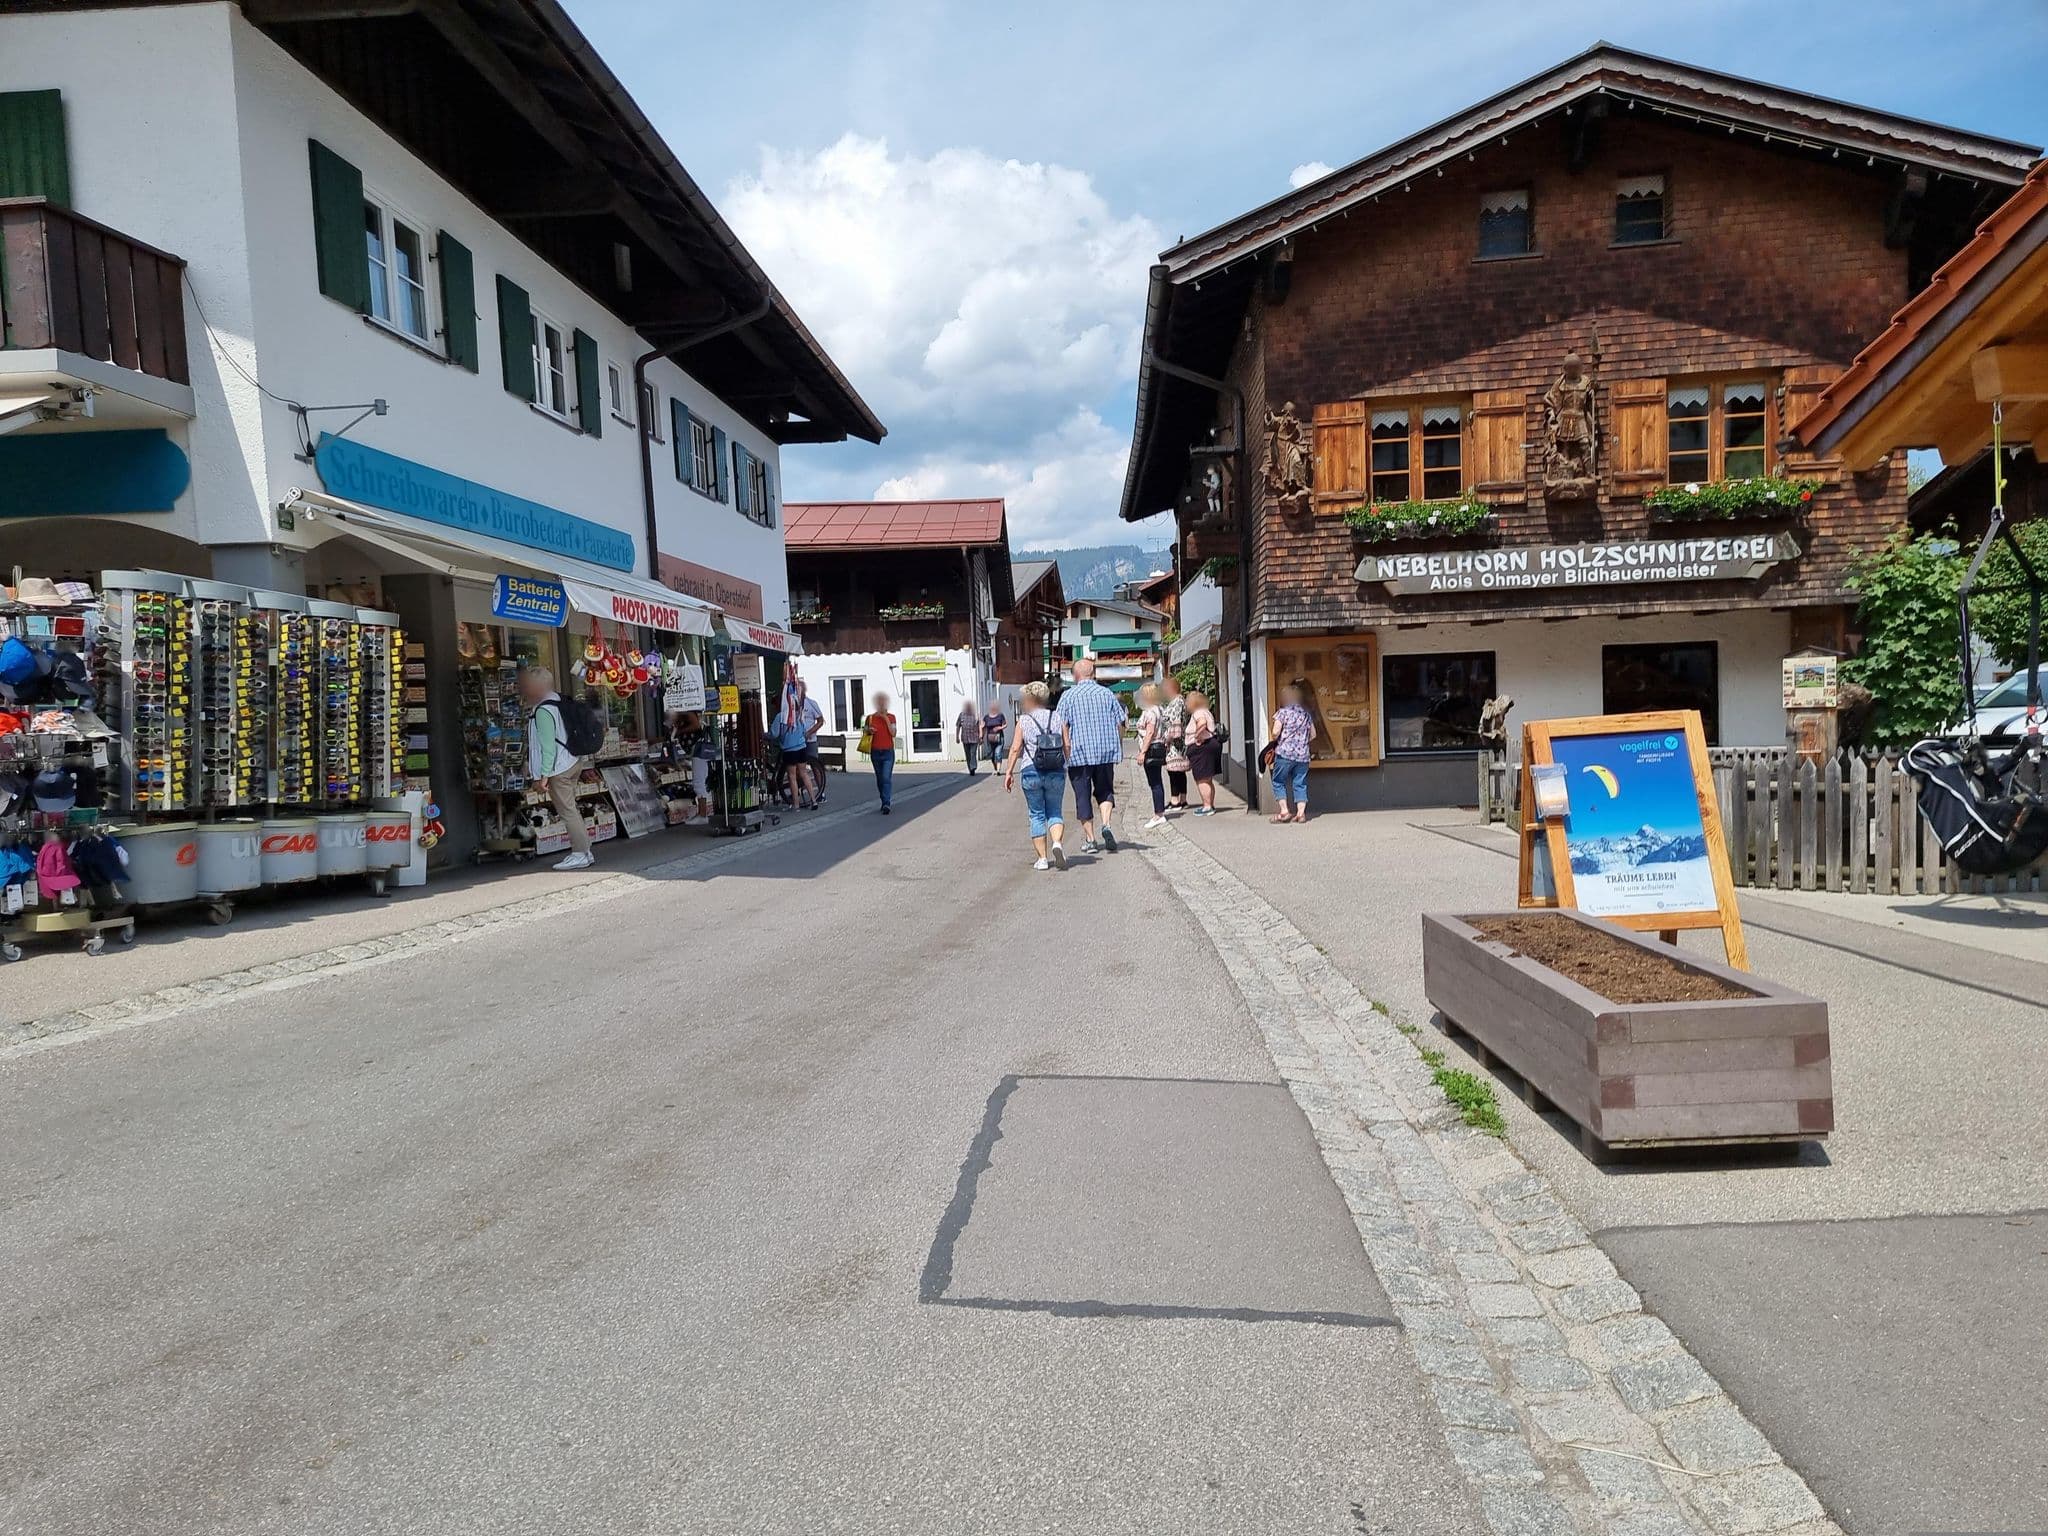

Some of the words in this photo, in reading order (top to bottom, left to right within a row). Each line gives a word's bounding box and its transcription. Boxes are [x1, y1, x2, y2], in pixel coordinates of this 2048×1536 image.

[331, 446, 479, 524] Schreibwaren
[491, 495, 575, 548] Bürobedarf
[583, 529, 632, 566] Papeterie
[1377, 552, 1528, 578] NEBELHORN
[1540, 537, 1774, 570] HOLZSCHNITZEREI
[508, 578, 561, 599] Batterie
[1430, 575, 1472, 590] Alois
[1481, 571, 1559, 588] Ohmayer
[1565, 563, 1718, 584] Bildhauermeister
[506, 593, 560, 613] Zentrale
[715, 582, 752, 610] Oberstdorf
[612, 596, 648, 624] PHOTO
[649, 604, 679, 630] PORST
[748, 626, 767, 646] PHOTO
[768, 632, 785, 650] PORST
[1619, 740, 1661, 753] vogelfrei
[1605, 873, 1644, 884] TRÄUME
[1647, 871, 1677, 881] LEBEN
